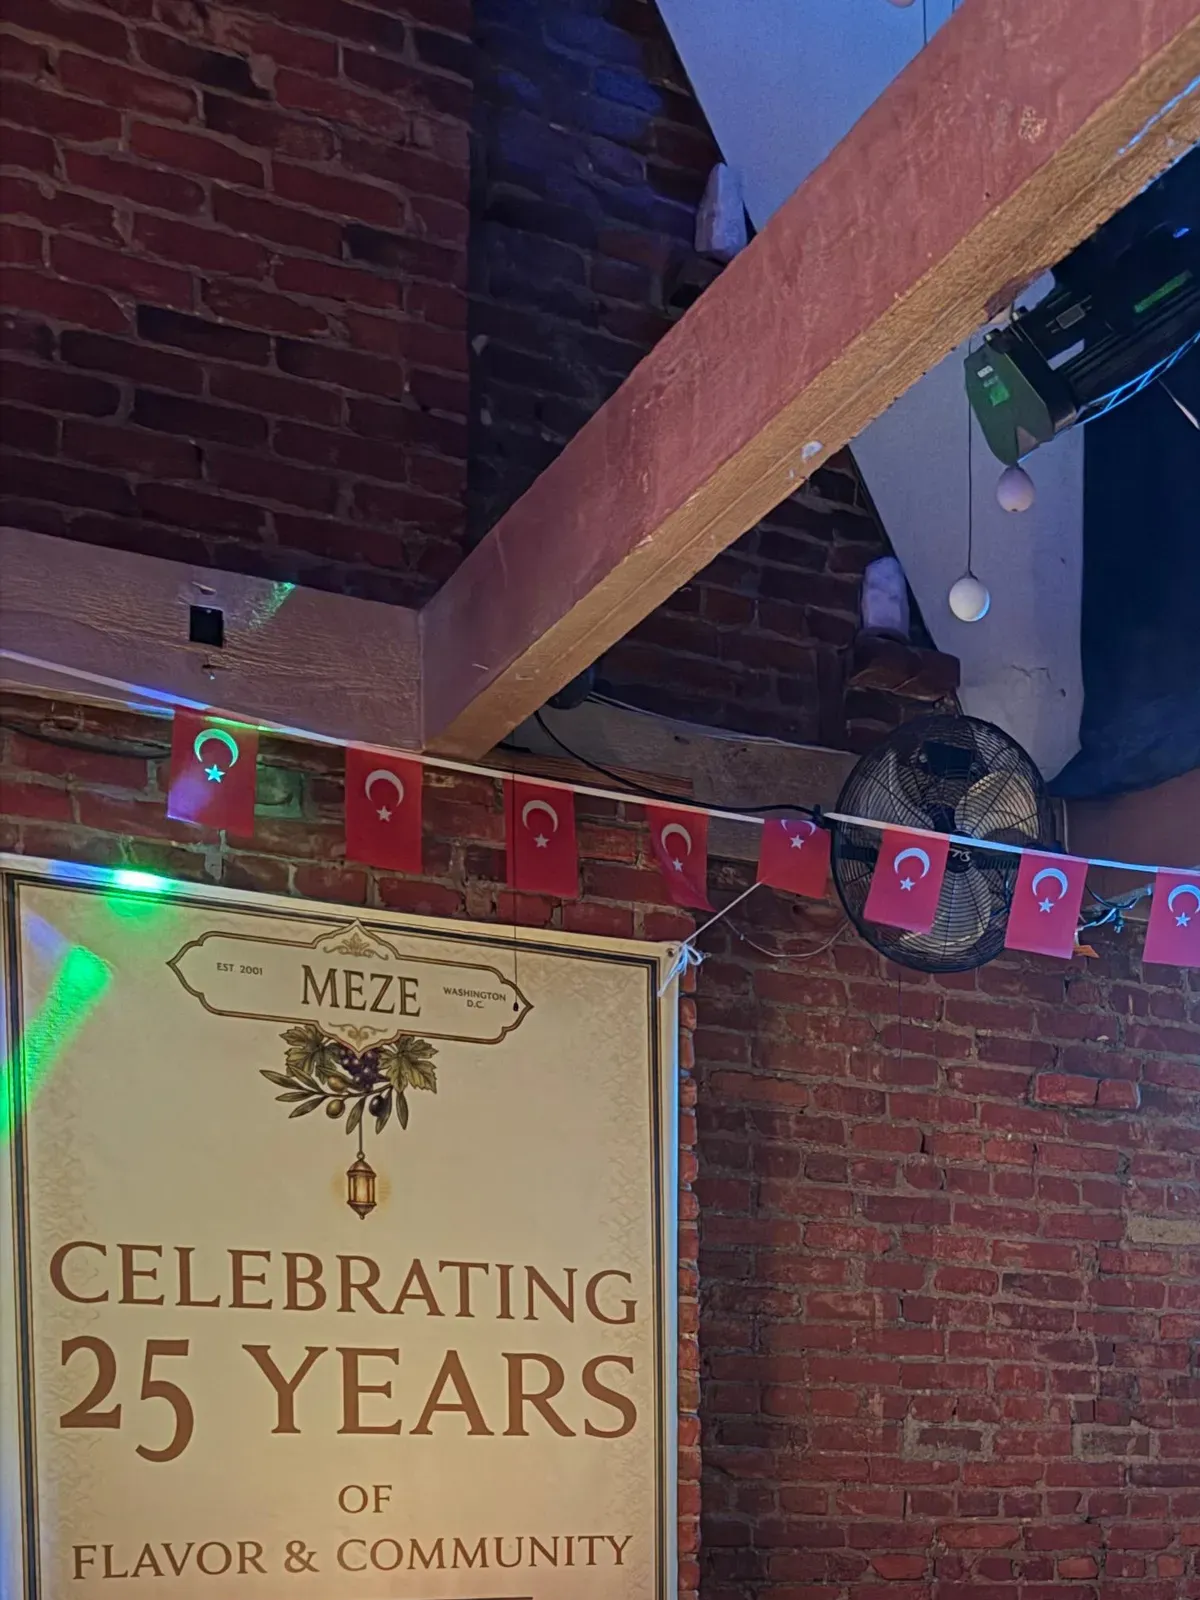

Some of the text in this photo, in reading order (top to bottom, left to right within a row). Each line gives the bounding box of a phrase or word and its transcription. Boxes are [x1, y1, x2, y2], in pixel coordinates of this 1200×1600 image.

[240, 965, 263, 976] 2001
[301, 964, 421, 1017] MEZE
[443, 986, 507, 1002] WASHINGTON
[49, 1240, 639, 1325] CELEBRATING
[59, 1335, 638, 1463] 25 YEARS
[338, 1484, 393, 1514] OF
[71, 1534, 634, 1580] FLAVOR & COMMUNITY
